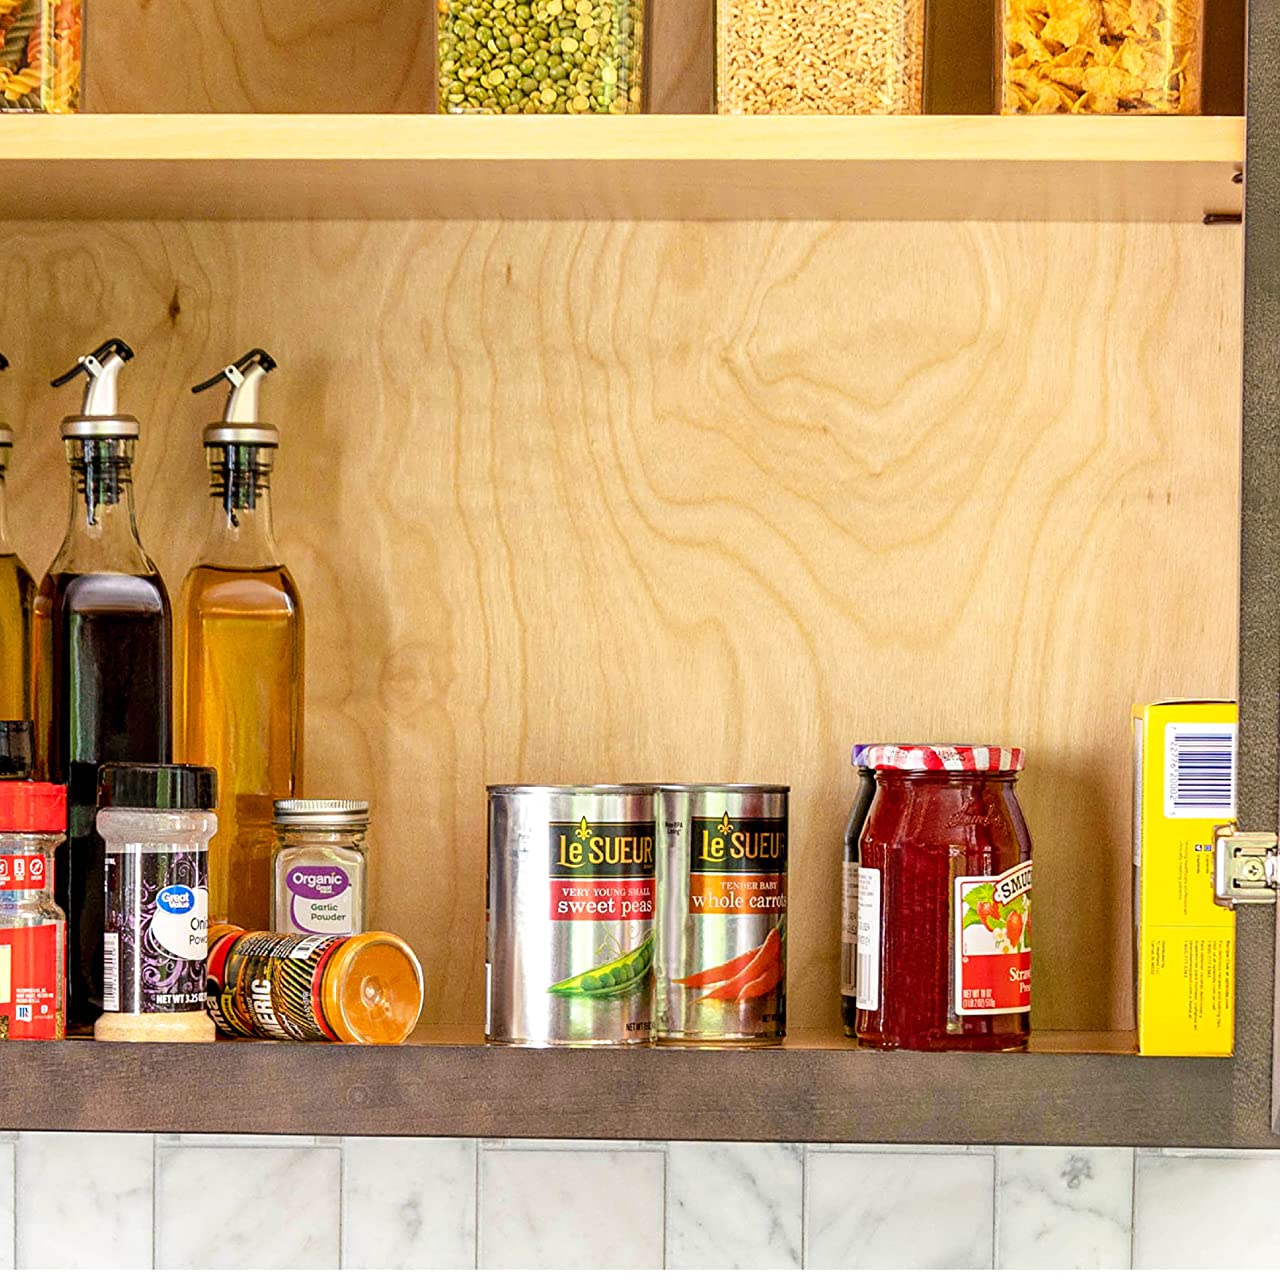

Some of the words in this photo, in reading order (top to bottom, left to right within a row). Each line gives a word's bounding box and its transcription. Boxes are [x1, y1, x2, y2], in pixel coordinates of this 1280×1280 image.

[587, 836, 654, 865] SUEUR
[292, 872, 342, 888] Organic
[720, 881, 758, 890] TENDER
[161, 891, 190, 903] Great
[561, 887, 590, 897] VERY
[592, 887, 626, 897] YOUNG
[627, 887, 651, 897] SMALL
[691, 891, 744, 909] whole
[310, 903, 339, 911] Garlic
[557, 897, 616, 914] sweet
[621, 900, 653, 918] peas
[310, 913, 347, 921] Powder
[156, 994, 172, 1005] NET
[172, 994, 185, 1004] WT
